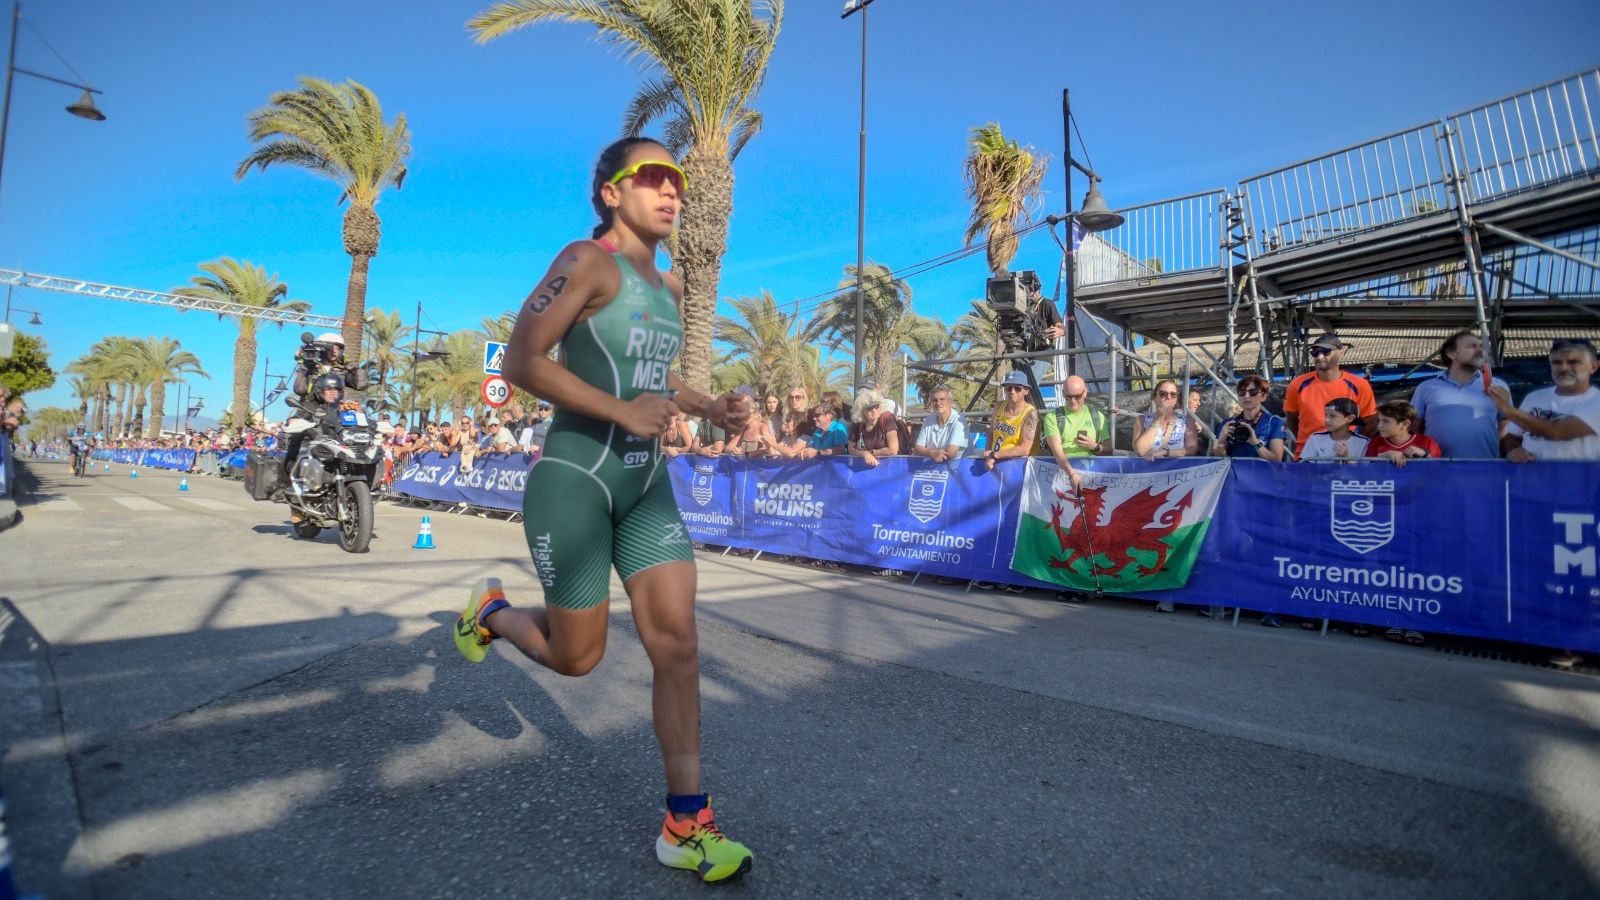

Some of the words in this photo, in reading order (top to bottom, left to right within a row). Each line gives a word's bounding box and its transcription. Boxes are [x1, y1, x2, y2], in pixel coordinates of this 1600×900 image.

[631, 359, 668, 391] MEX
[489, 385, 506, 397] 30
[993, 436, 1003, 452] 6
[757, 483, 813, 500] TORRE
[678, 508, 733, 526] orremolinos
[754, 498, 825, 519] MOLINOS
[872, 524, 975, 550] Torremolinos
[1553, 512, 1600, 545] T
[877, 545, 961, 564] AYUNTAMIENTO
[1273, 556, 1463, 594] Torremolinos
[1290, 586, 1442, 615] AYUNTAMIENTO
